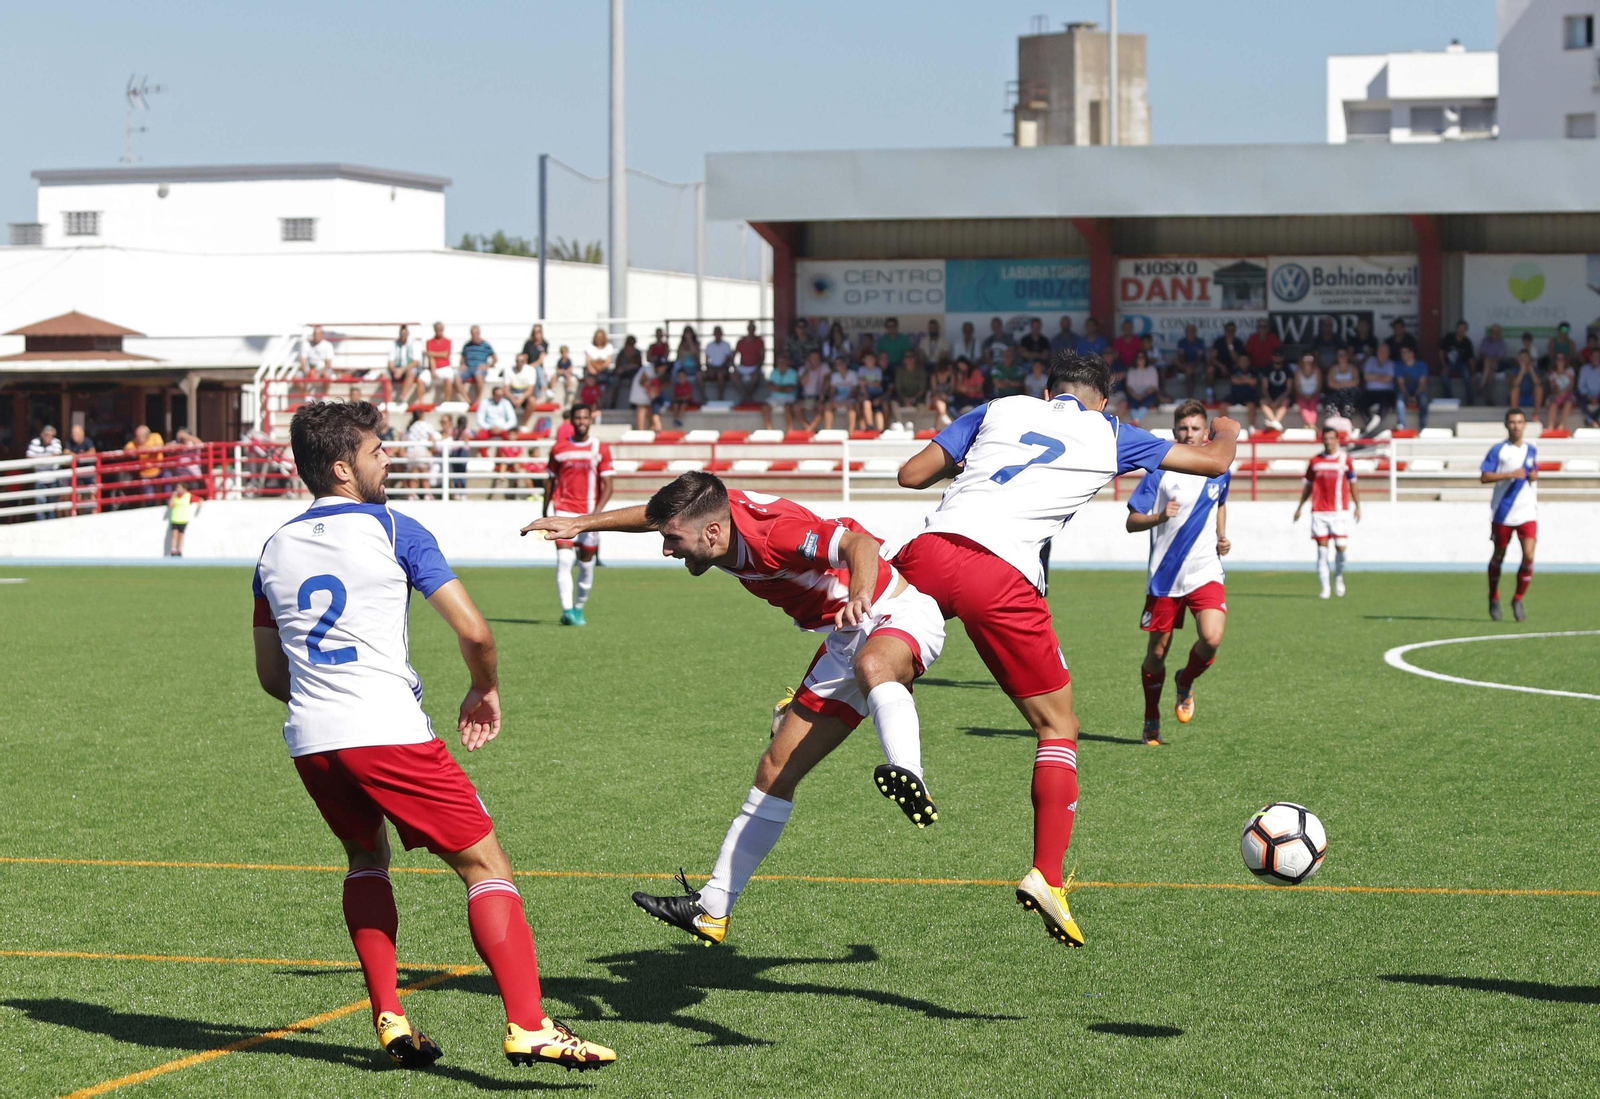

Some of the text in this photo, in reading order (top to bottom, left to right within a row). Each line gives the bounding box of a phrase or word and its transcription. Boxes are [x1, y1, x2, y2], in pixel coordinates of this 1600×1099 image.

[844, 268, 943, 284] CENTRO
[1134, 260, 1197, 276] KIOSKO
[844, 288, 944, 305] OPTICO
[1121, 276, 1211, 302] DANI
[989, 431, 1066, 486] 7
[297, 574, 358, 666] 2
